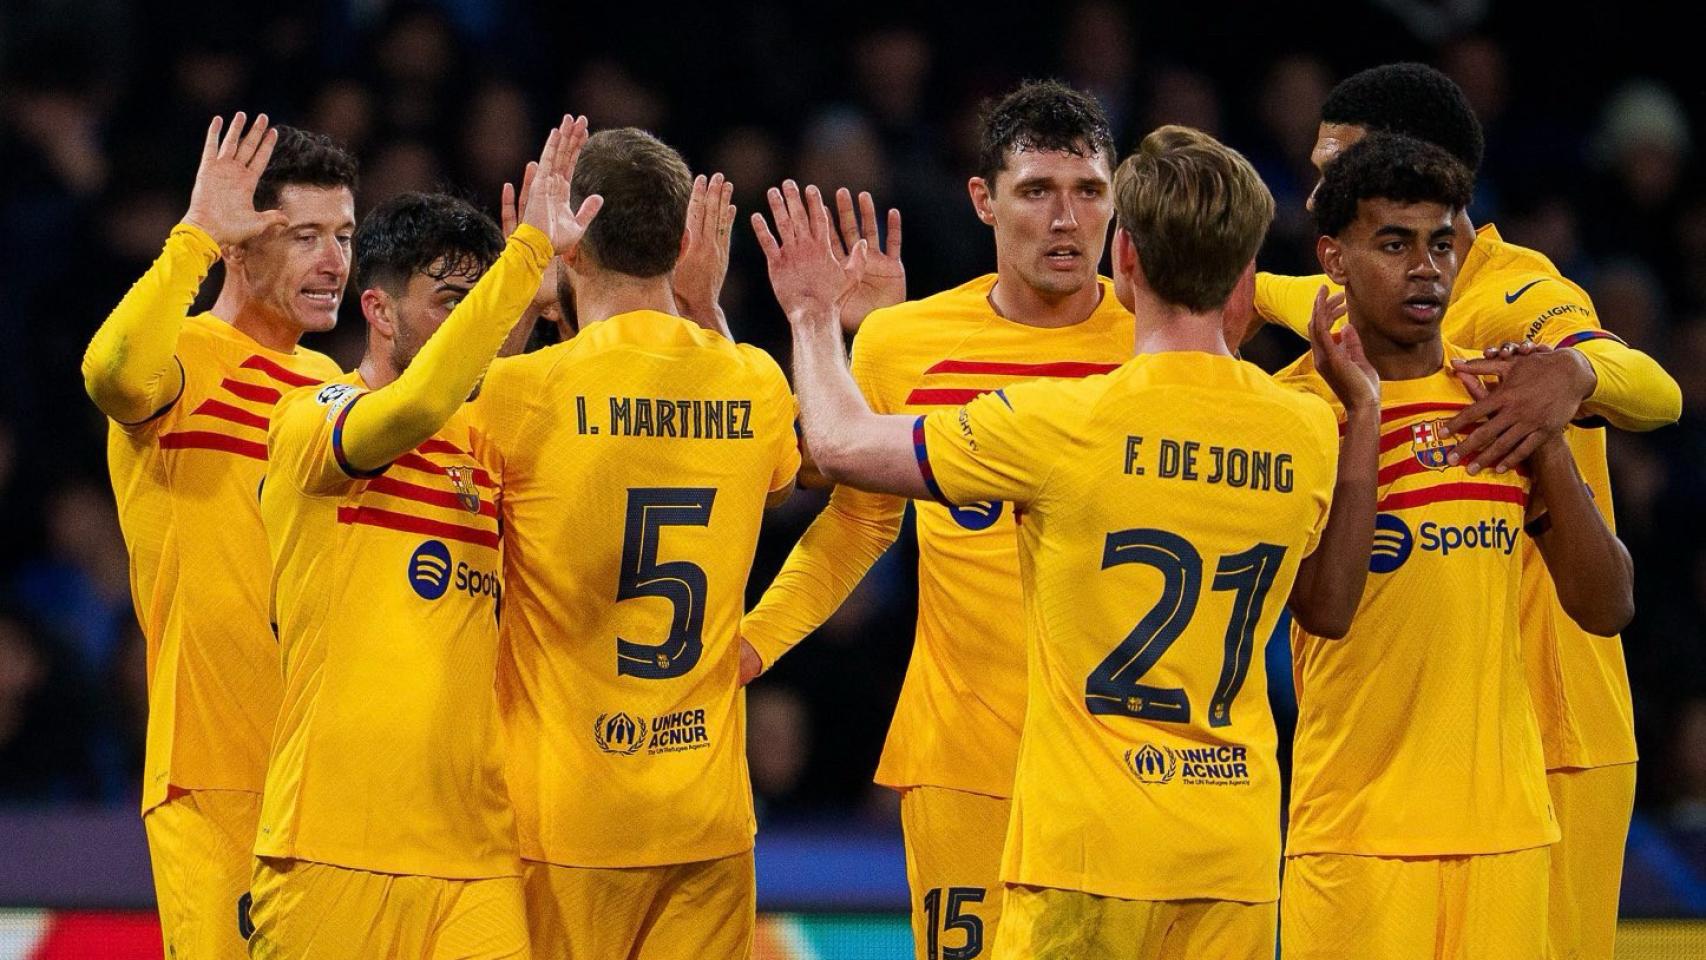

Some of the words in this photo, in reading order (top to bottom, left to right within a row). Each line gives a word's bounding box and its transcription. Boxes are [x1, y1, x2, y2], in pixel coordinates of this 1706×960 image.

[1526, 304, 1577, 342] MBILIGHT
[576, 396, 599, 435] I.
[609, 397, 754, 439] MARTINEZ
[1124, 435, 1145, 475] F.
[1158, 439, 1200, 481] DE
[1207, 446, 1294, 493] JONG
[1420, 517, 1520, 556] Spotify
[615, 487, 718, 680] 5
[1084, 528, 1289, 728] 21
[648, 726, 709, 748] ACNUR
[651, 709, 705, 732] UNHCR
[1175, 746, 1247, 762] UNHCR
[1182, 763, 1249, 778] ACNUR
[924, 887, 987, 960] 15
